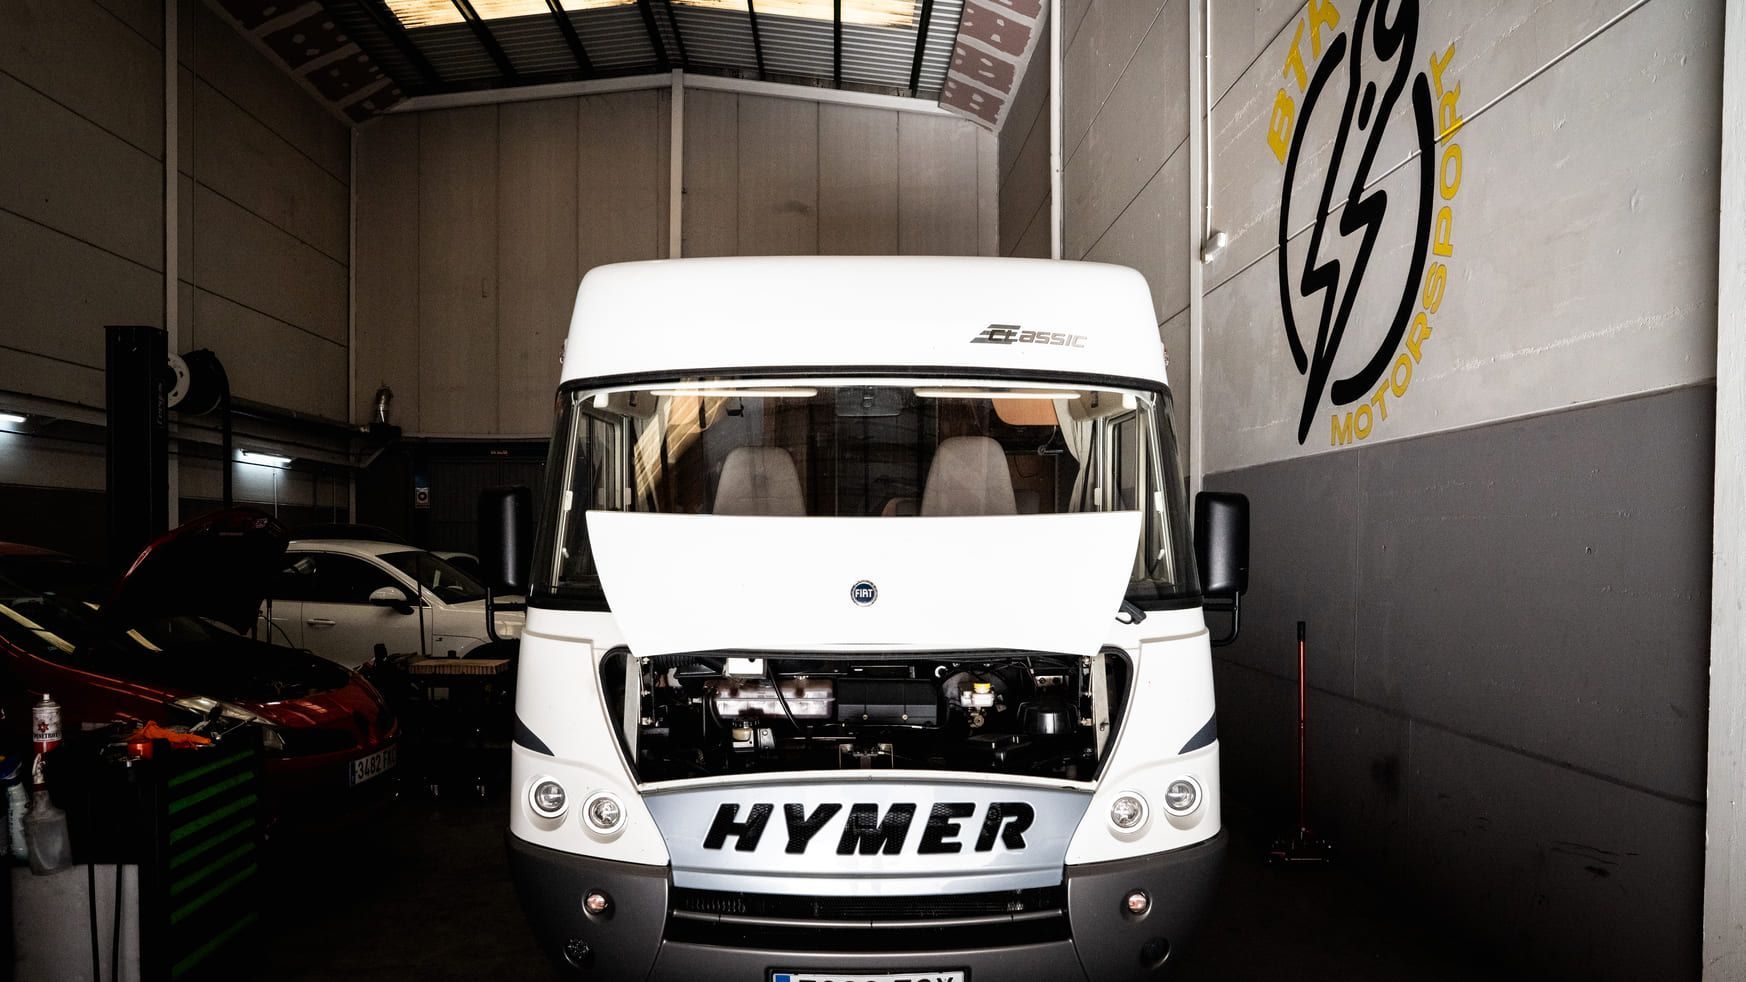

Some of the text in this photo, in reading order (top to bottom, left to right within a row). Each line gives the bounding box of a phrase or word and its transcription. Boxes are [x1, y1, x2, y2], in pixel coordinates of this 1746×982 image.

[1329, 42, 1465, 447] MOTORSPORT
[855, 588, 873, 598] FIAT
[358, 754, 381, 779] 3482
[703, 802, 1036, 856] HYMER
